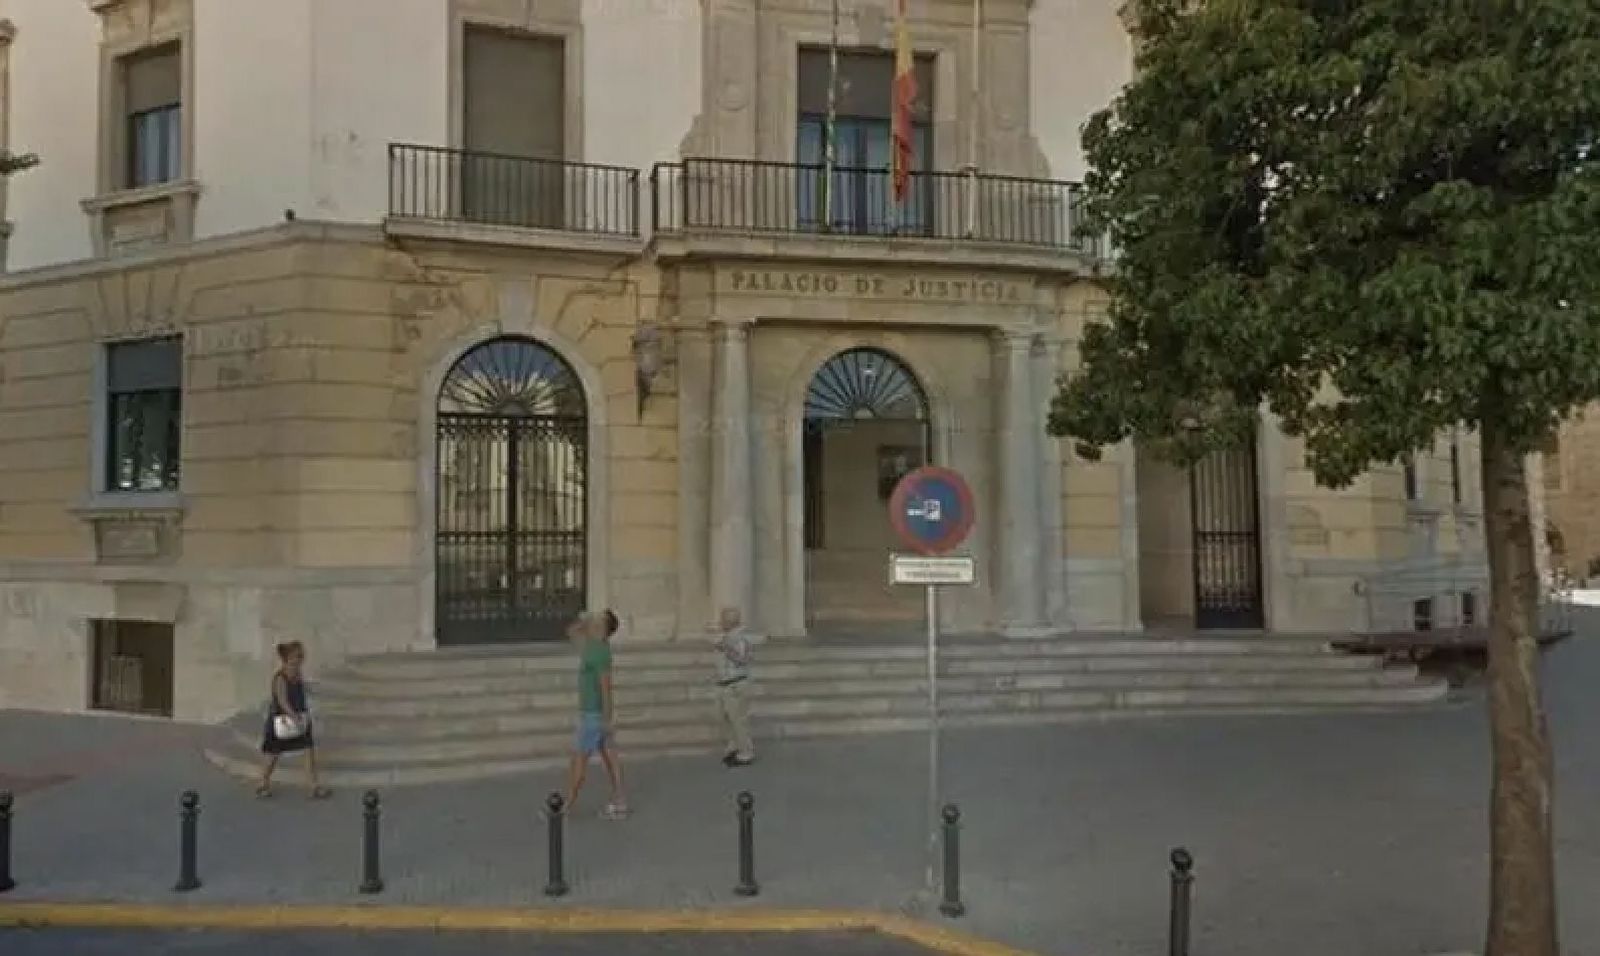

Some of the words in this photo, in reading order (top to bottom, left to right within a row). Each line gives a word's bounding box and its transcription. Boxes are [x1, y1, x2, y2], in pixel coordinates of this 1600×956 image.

[731, 271, 838, 293] PALACIO
[855, 275, 885, 295] DE
[903, 274, 1020, 300] JUSTICIA
